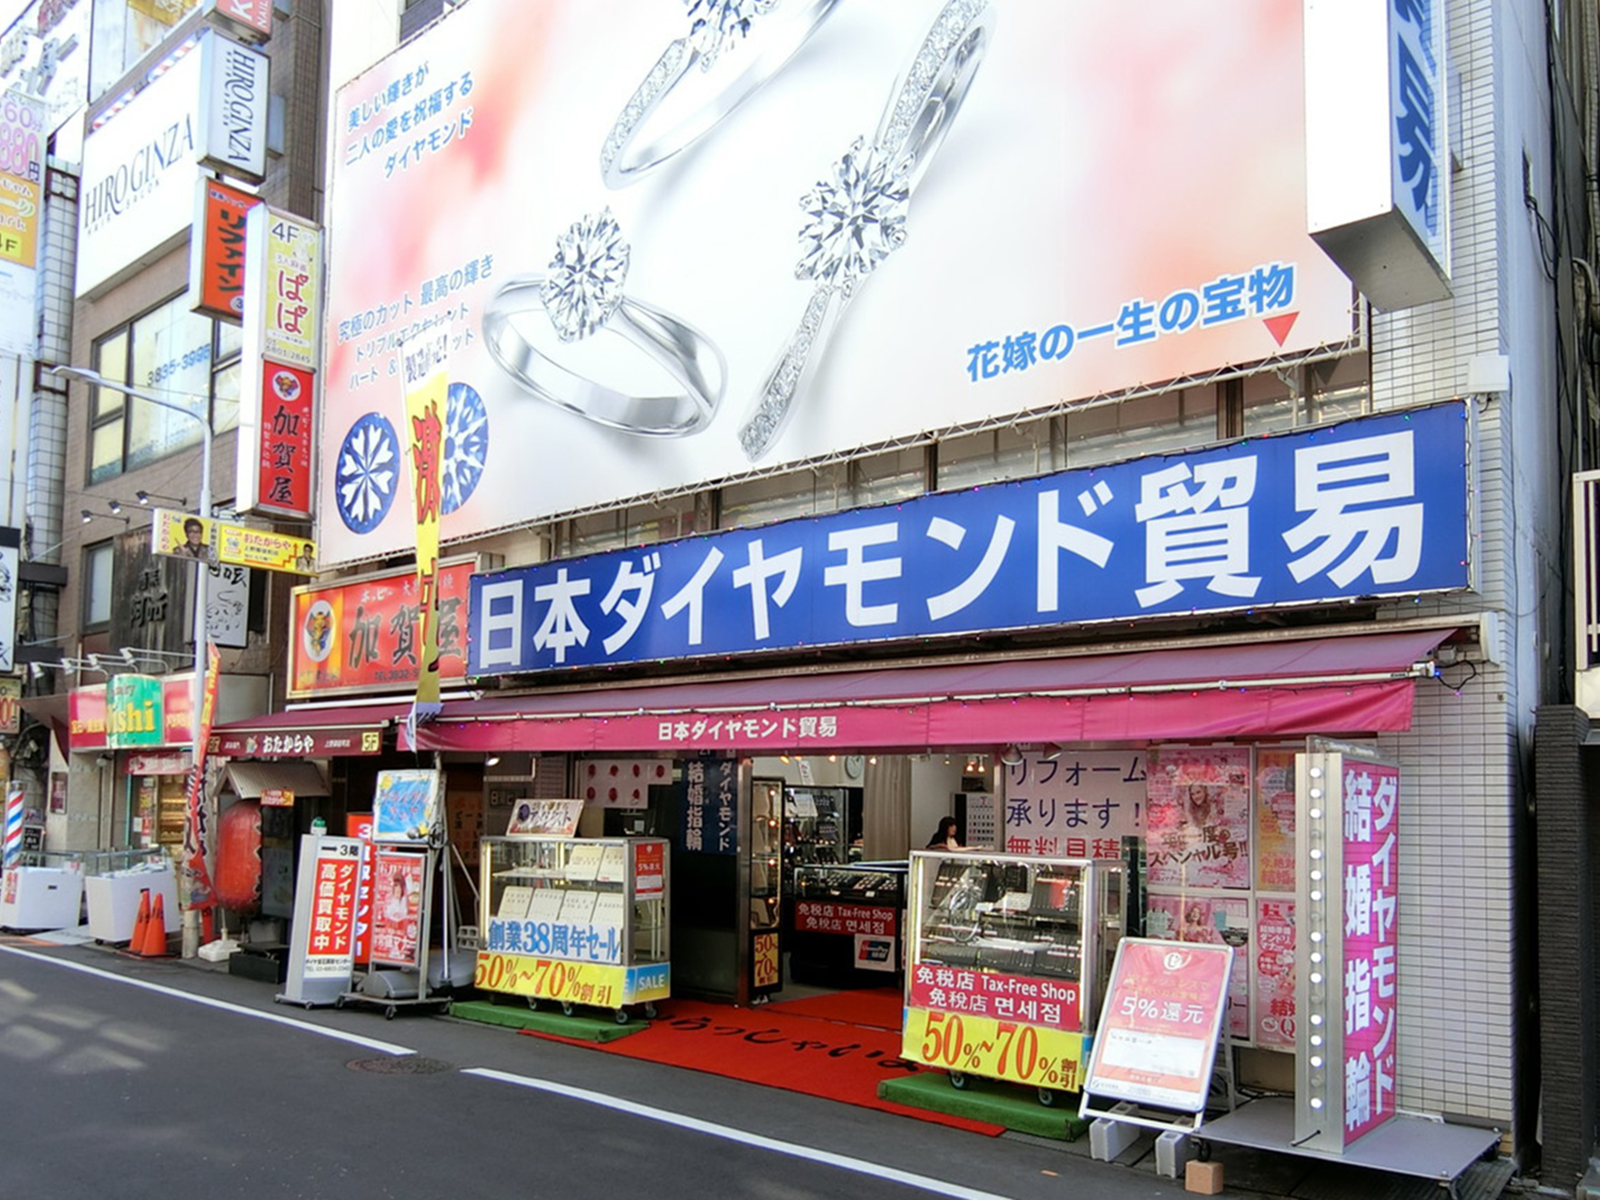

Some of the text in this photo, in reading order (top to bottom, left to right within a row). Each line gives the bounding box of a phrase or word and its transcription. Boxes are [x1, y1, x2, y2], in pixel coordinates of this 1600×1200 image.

[225, 49, 255, 162] HIROGINZA
[346, 71, 474, 166] 二人の愛を祝福する
[348, 61, 430, 132] 美しい輝きが
[84, 113, 194, 229] HIROGINZA
[384, 108, 473, 179] ダイヤモンド
[271, 222, 300, 243] 4F
[277, 270, 309, 334] ぱぱ
[338, 293, 413, 343] 究極のカット
[420, 254, 494, 306] 最高の輝き
[966, 263, 1298, 384] 花嫁の一生の宝物
[350, 358, 397, 389] ハート &
[269, 405, 300, 505] 加賀屋
[244, 533, 291, 550] おたからや
[477, 429, 1427, 669] 日本ダイヤモンド貿易
[349, 597, 462, 669] 加賀屋
[262, 734, 315, 753] おたからや
[365, 733, 379, 750] 5F
[658, 715, 837, 741] 日本ダイヤモンド貿易
[1010, 756, 1147, 786] リフォーム
[718, 761, 732, 851] ダイヤモンド
[1007, 798, 1140, 829] 承ります！
[340, 845, 359, 857] 3階
[314, 863, 337, 950] 高価買取中
[334, 864, 355, 950] ダイヤモンド
[872, 909, 893, 921] Shop
[487, 920, 622, 962] 創業38周年セール
[1344, 769, 1373, 1132] 結婚指輪
[1372, 775, 1397, 1116] ダイヤモンド
[638, 973, 665, 991] SALE
[916, 966, 1076, 1003] 免税店 Tax-Free Shop
[994, 996, 1061, 1024] 면세점
[1120, 996, 1204, 1024] 5%還元
